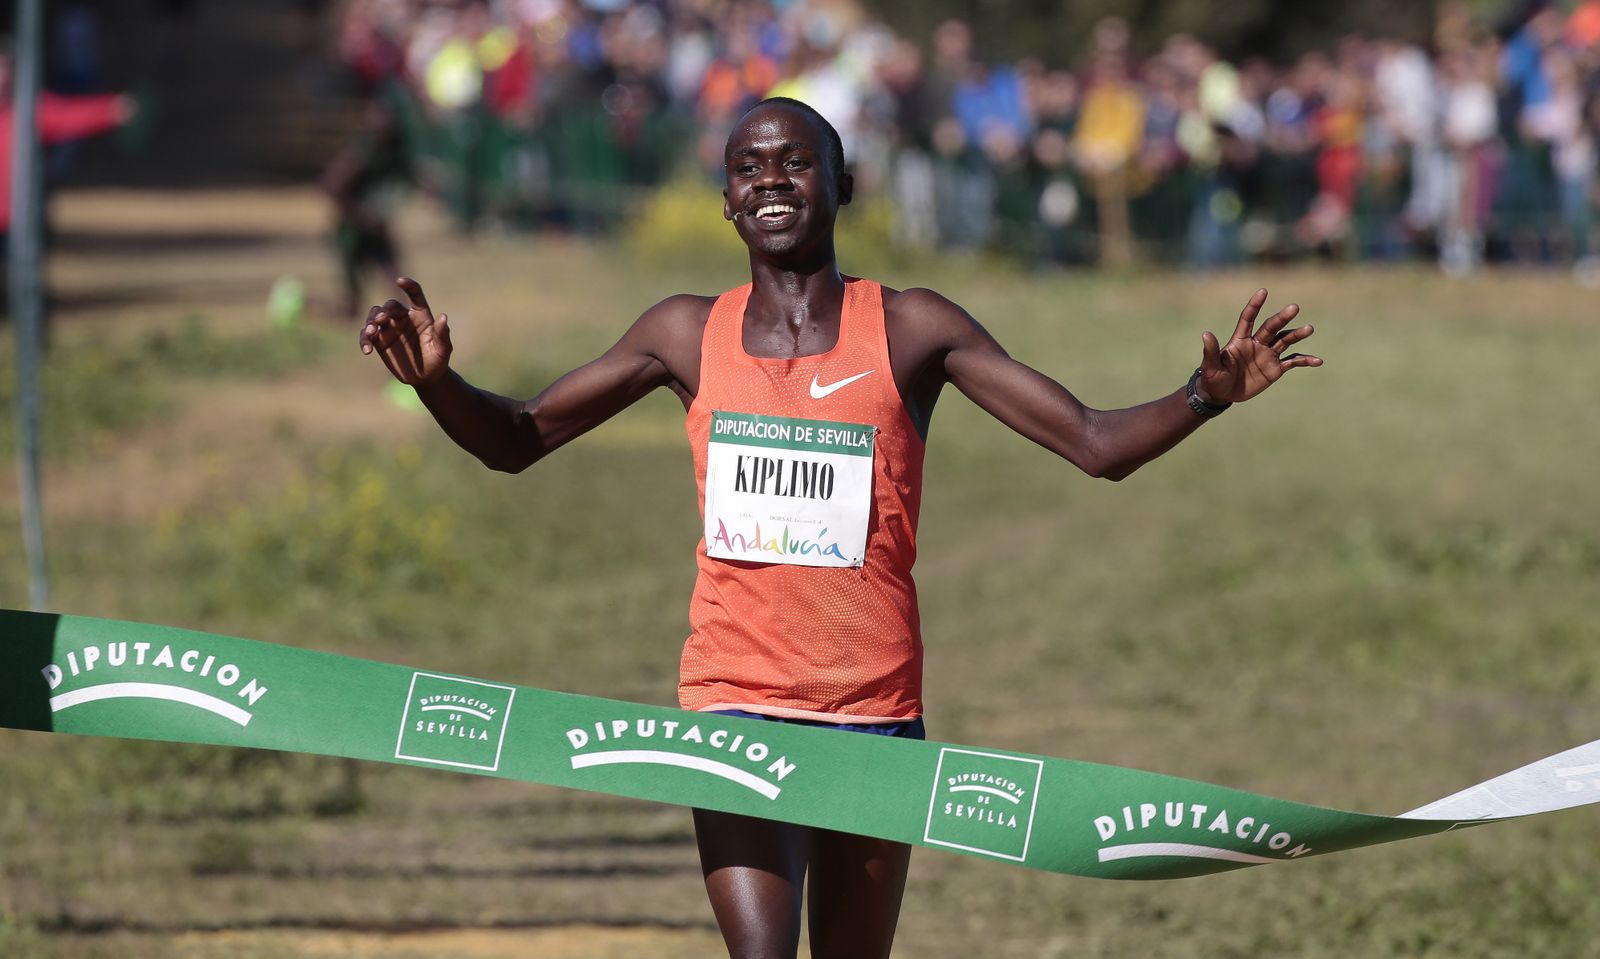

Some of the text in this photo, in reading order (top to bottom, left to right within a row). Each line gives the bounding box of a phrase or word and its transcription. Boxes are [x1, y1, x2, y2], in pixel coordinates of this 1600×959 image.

[715, 419, 868, 448] DIPUTACION DE SEVILLA
[734, 455, 835, 500] KIPLIMO
[713, 517, 849, 561] Andalucía
[41, 641, 268, 706] DIPUTACION
[420, 695, 497, 715] DIPUTACION
[449, 713, 462, 721] DE
[416, 720, 489, 741] SEVILLA
[566, 719, 797, 781] DIPUTACION
[948, 773, 1025, 797] DIPUTACION
[978, 795, 991, 804] DE
[944, 802, 1017, 828] SEVILLA
[1094, 802, 1312, 858] DIPUTACION
